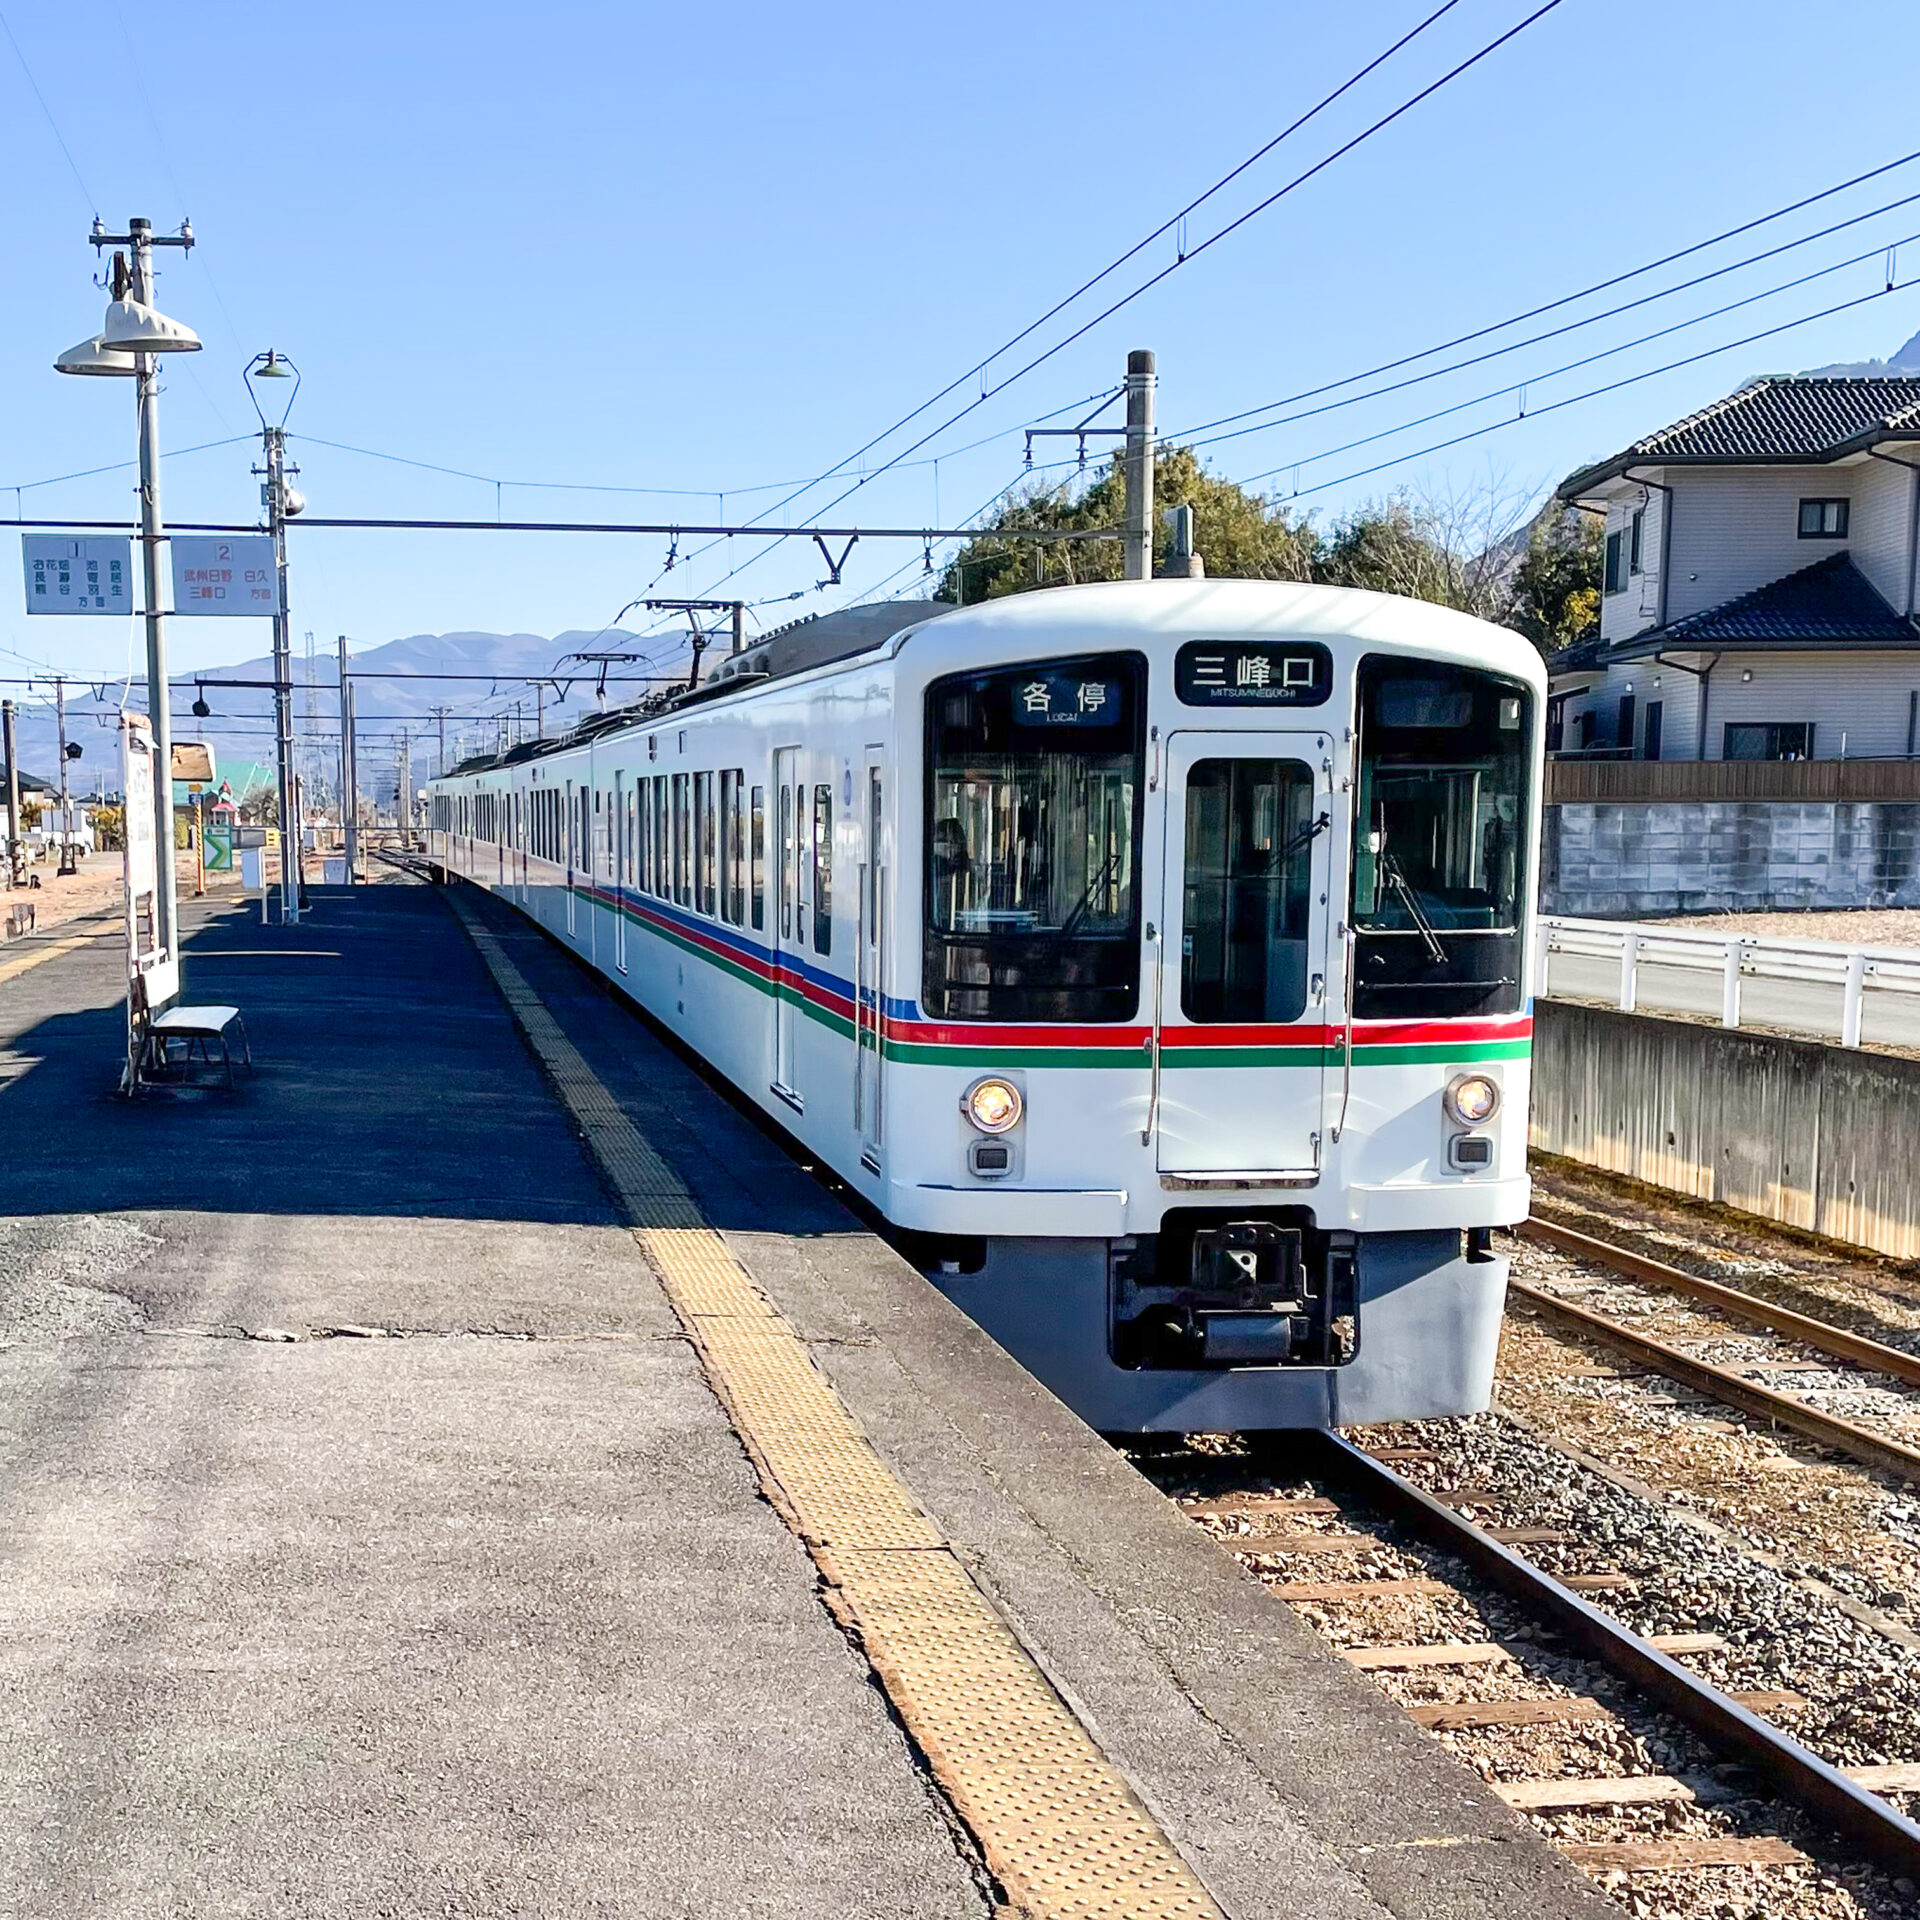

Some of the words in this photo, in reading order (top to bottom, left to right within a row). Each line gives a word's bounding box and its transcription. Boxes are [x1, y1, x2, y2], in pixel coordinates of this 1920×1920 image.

[219, 545, 230, 560] 2
[33, 559, 70, 571] お花畑
[86, 560, 121, 571] 池袋
[184, 569, 232, 583] 武州日野
[189, 586, 226, 599] 三峰口
[250, 588, 271, 600] 方面
[1193, 655, 1314, 687] 三峰口
[1023, 682, 1106, 712] 各停
[1210, 688, 1296, 698] MITSUMINEGUCHI
[1046, 712, 1078, 722] LOCAL
